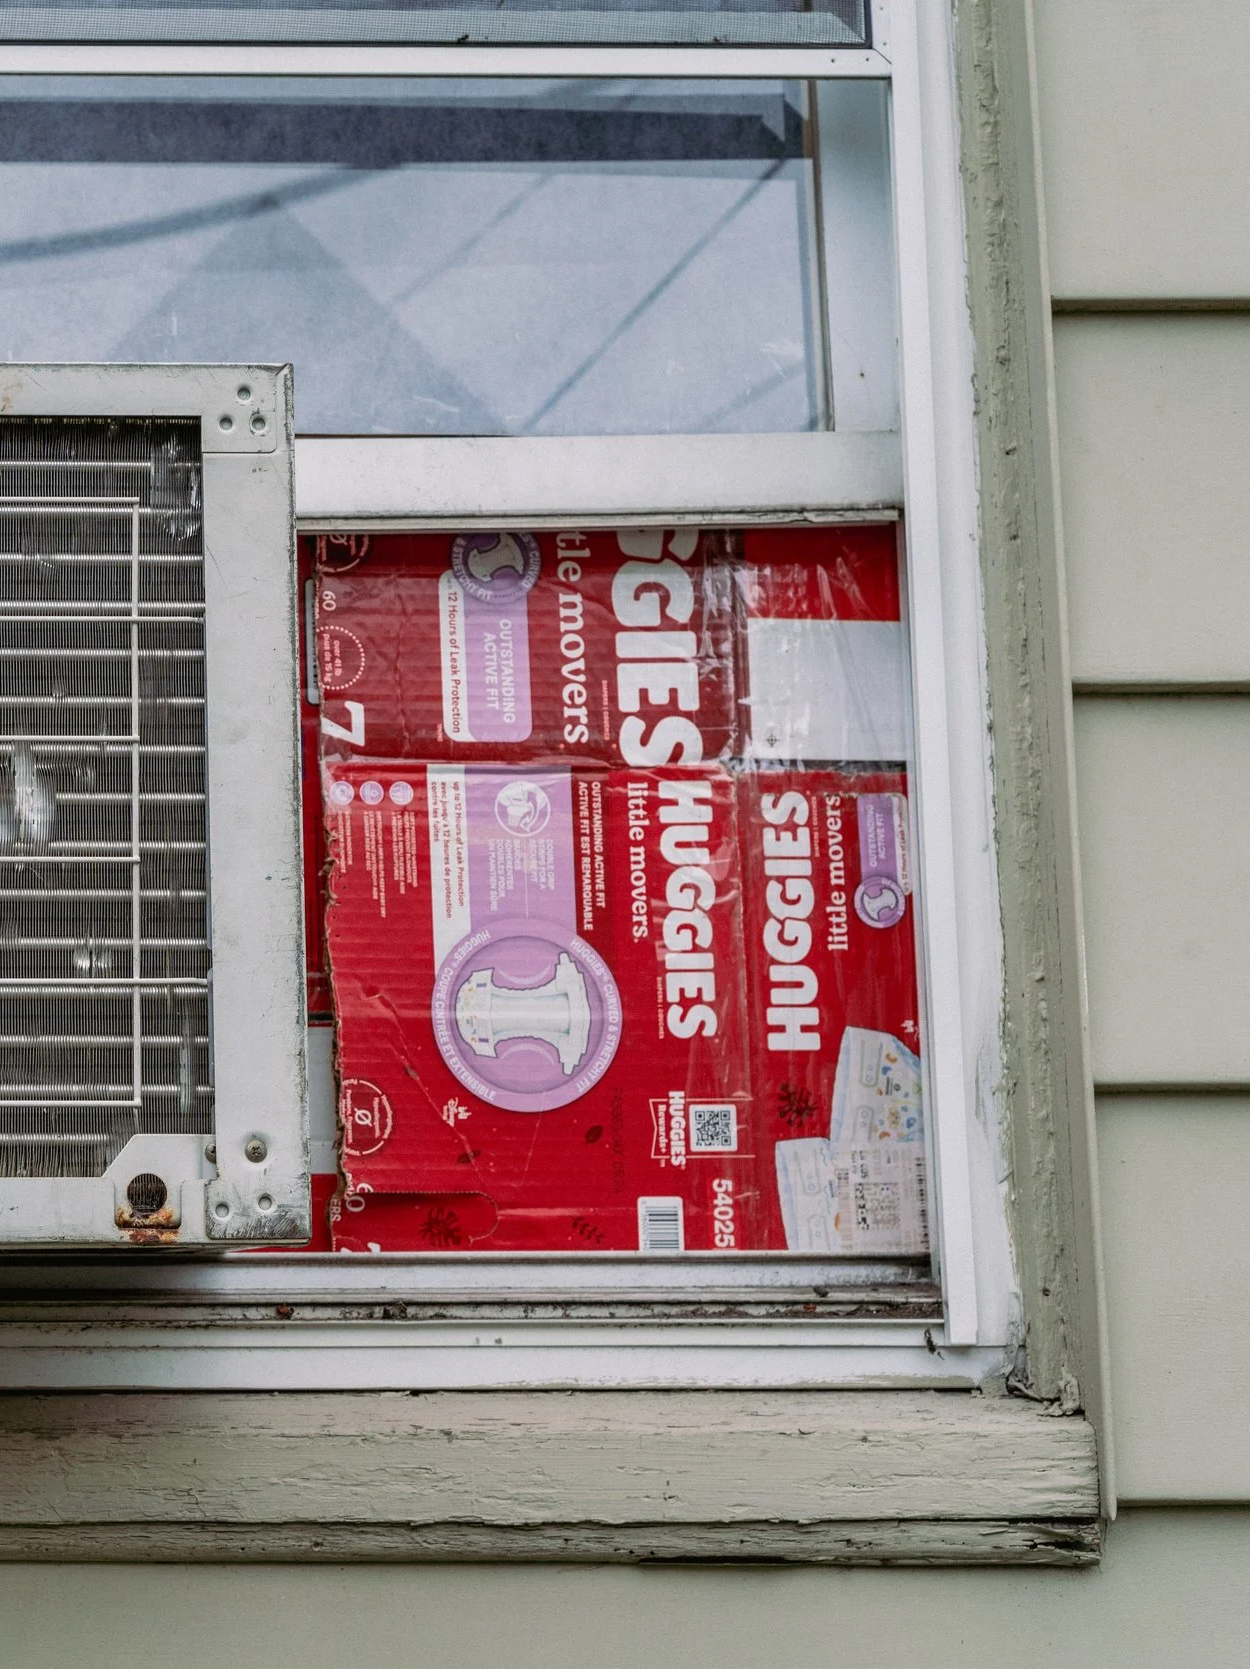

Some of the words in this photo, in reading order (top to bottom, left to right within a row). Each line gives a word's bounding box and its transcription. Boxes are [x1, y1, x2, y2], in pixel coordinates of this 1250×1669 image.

[522, 550, 540, 588] CURVED
[322, 591, 337, 612] 60
[449, 591, 458, 603] 12
[449, 605, 459, 637] Hours
[450, 639, 460, 650] of
[483, 632, 497, 685] ACTIVE
[450, 652, 461, 676] Leak
[498, 619, 516, 724] OUTSTANDING
[451, 680, 462, 734] Protection
[485, 688, 499, 711] FIT
[321, 701, 366, 748] 7
[454, 793, 460, 801] to
[455, 803, 462, 811] 12
[578, 781, 590, 817] ACTIVE
[626, 782, 650, 841] little
[443, 830, 450, 838] 12
[455, 813, 463, 836] Hours
[580, 820, 590, 834] FIT
[591, 781, 603, 852] OUTSTANDING
[444, 840, 452, 865] heures
[456, 838, 463, 846] of
[581, 836, 591, 854] EST
[825, 795, 847, 885] movers
[445, 867, 452, 877] de
[458, 867, 466, 907] Protection
[594, 855, 605, 890] ACTIVE
[445, 879, 454, 919] protection
[582, 857, 595, 931] REMARQUABLE
[596, 892, 606, 908] FIT
[657, 781, 718, 1040] HUGGIES
[760, 791, 821, 1051] HUGGIES
[825, 891, 849, 951] little
[435, 967, 454, 998] COUPE
[603, 984, 619, 1023] CURVED
[441, 1045, 453, 1057] ET
[587, 1034, 617, 1078] STRETCHY
[449, 1059, 496, 1101] EXTENSIBLE
[575, 1075, 594, 1094] FIT
[668, 1091, 686, 1166] HUGGIES
[713, 1178, 735, 1248] 54025
